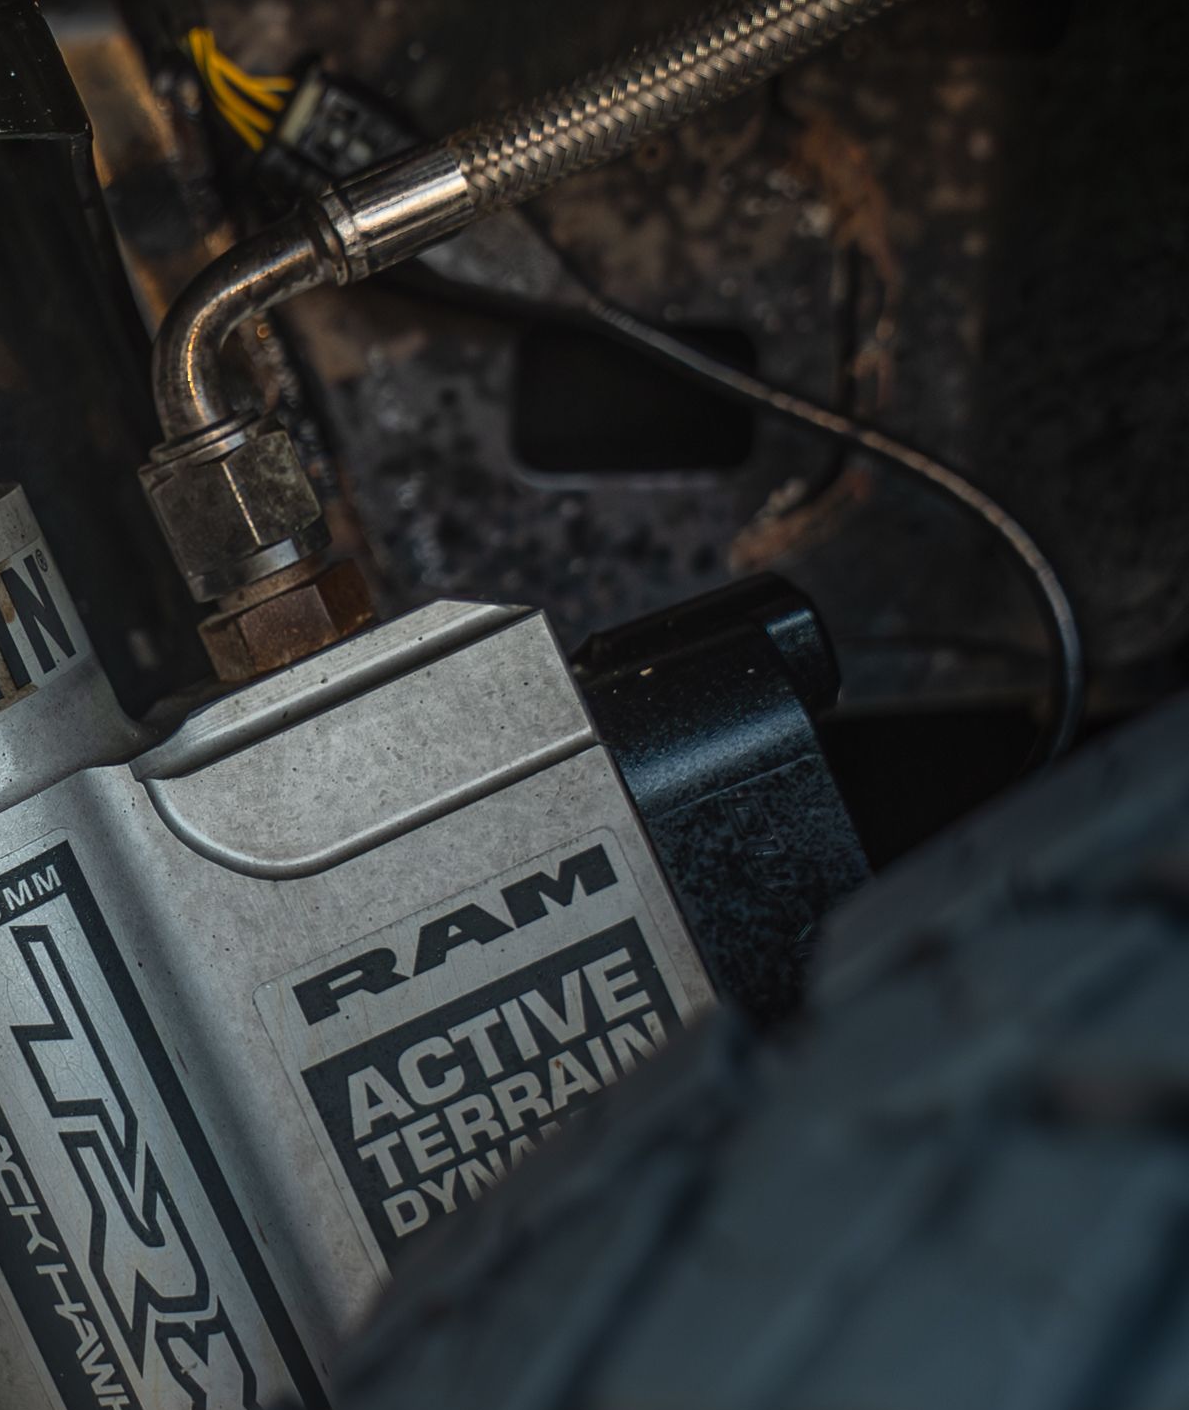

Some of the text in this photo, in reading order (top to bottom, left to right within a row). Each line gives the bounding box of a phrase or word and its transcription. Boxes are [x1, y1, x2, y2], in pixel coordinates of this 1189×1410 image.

[4, 864, 64, 912] MM
[292, 844, 618, 1025] RAM
[347, 948, 651, 1141] ACTIVE
[357, 1011, 668, 1189] TERRAIN
[382, 1108, 587, 1238] DYNA
